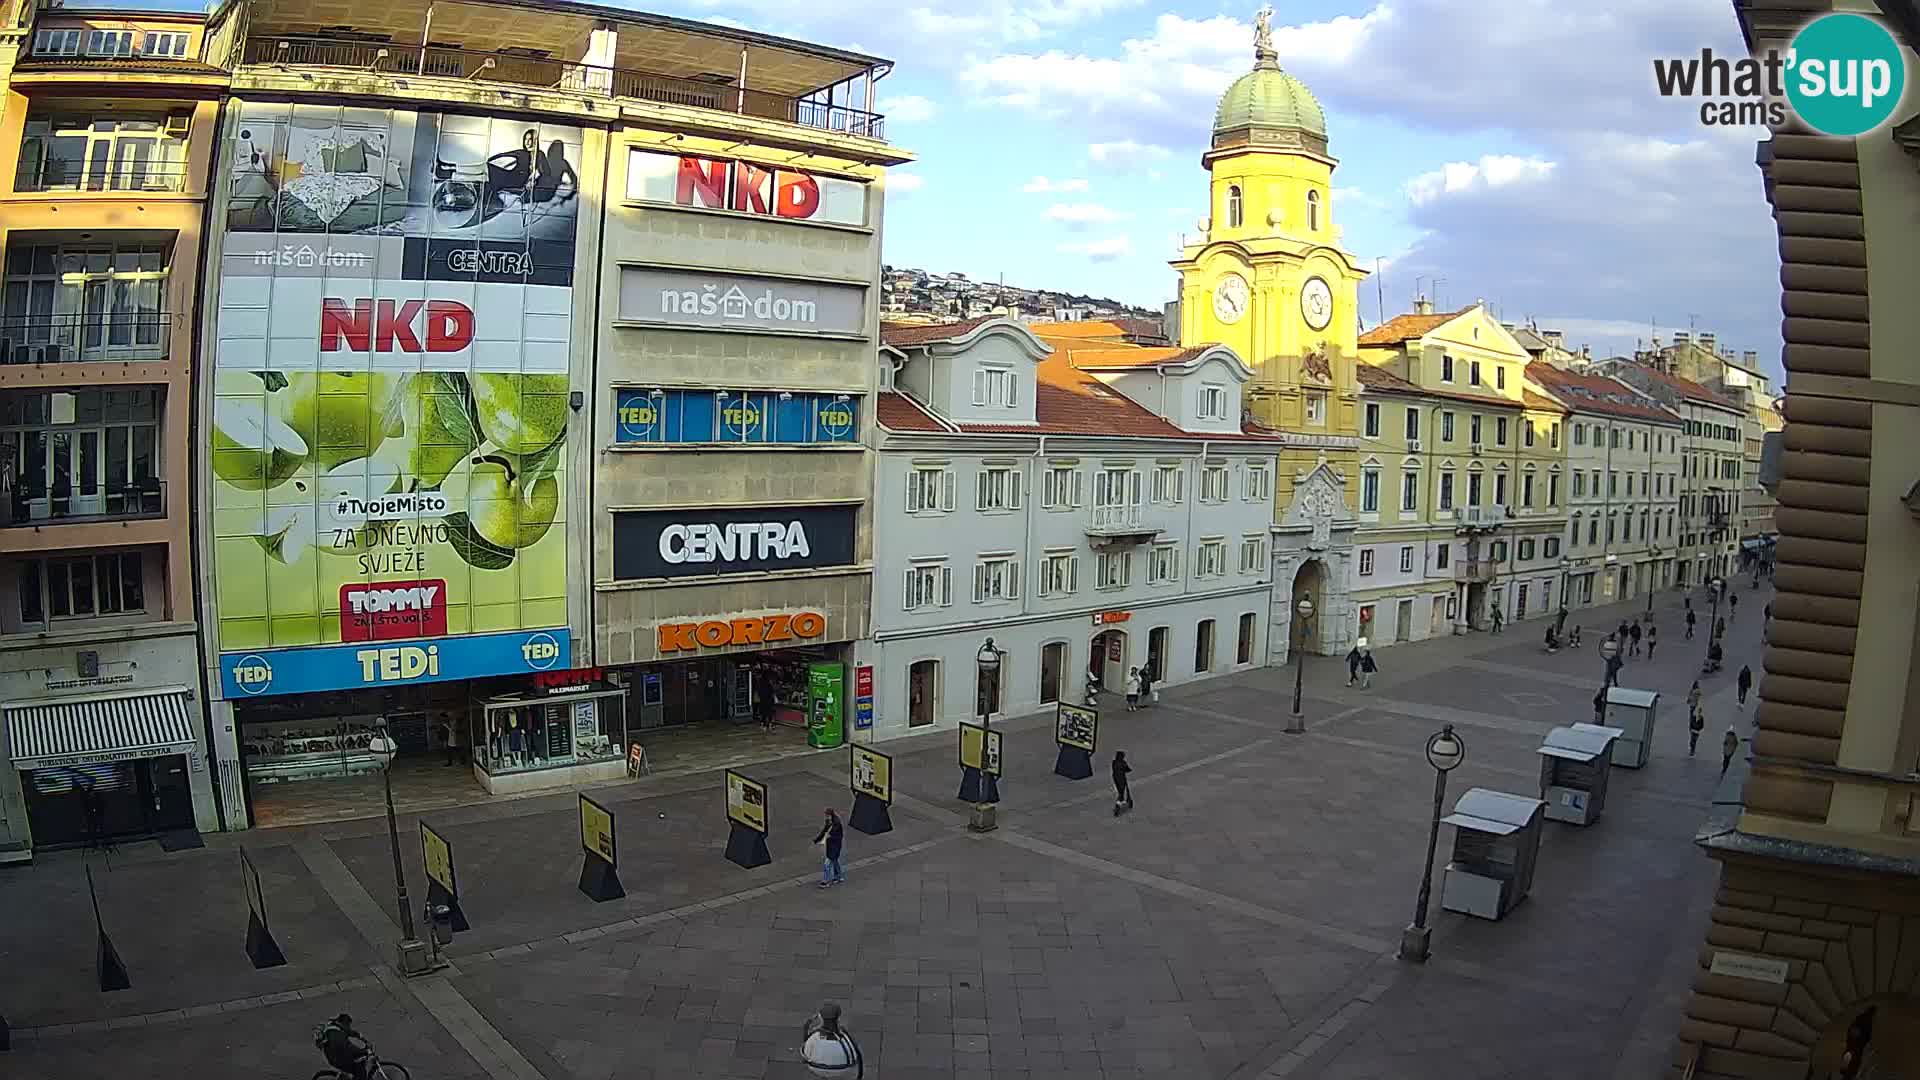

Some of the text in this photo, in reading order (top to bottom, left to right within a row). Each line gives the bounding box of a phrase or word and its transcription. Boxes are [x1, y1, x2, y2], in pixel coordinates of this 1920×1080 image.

[675, 154, 821, 219] NKD
[254, 244, 367, 267] naš dom
[447, 249, 534, 276] CENTRA
[660, 284, 817, 323] naš dom
[320, 296, 477, 353] NKD
[618, 407, 658, 425] TEDi
[723, 409, 760, 425] TEDi
[819, 410, 853, 426] TEDi
[337, 496, 446, 516] #TvojeMisto
[333, 523, 450, 549] ZA DNEVNO
[658, 520, 811, 564] CENTRA
[359, 547, 425, 575] SVJEŽE
[347, 586, 439, 614] TOMMY
[658, 612, 826, 653] KORZO
[357, 645, 441, 683] TEDi
[522, 641, 560, 660] TEDi
[232, 665, 273, 684] TEDi
